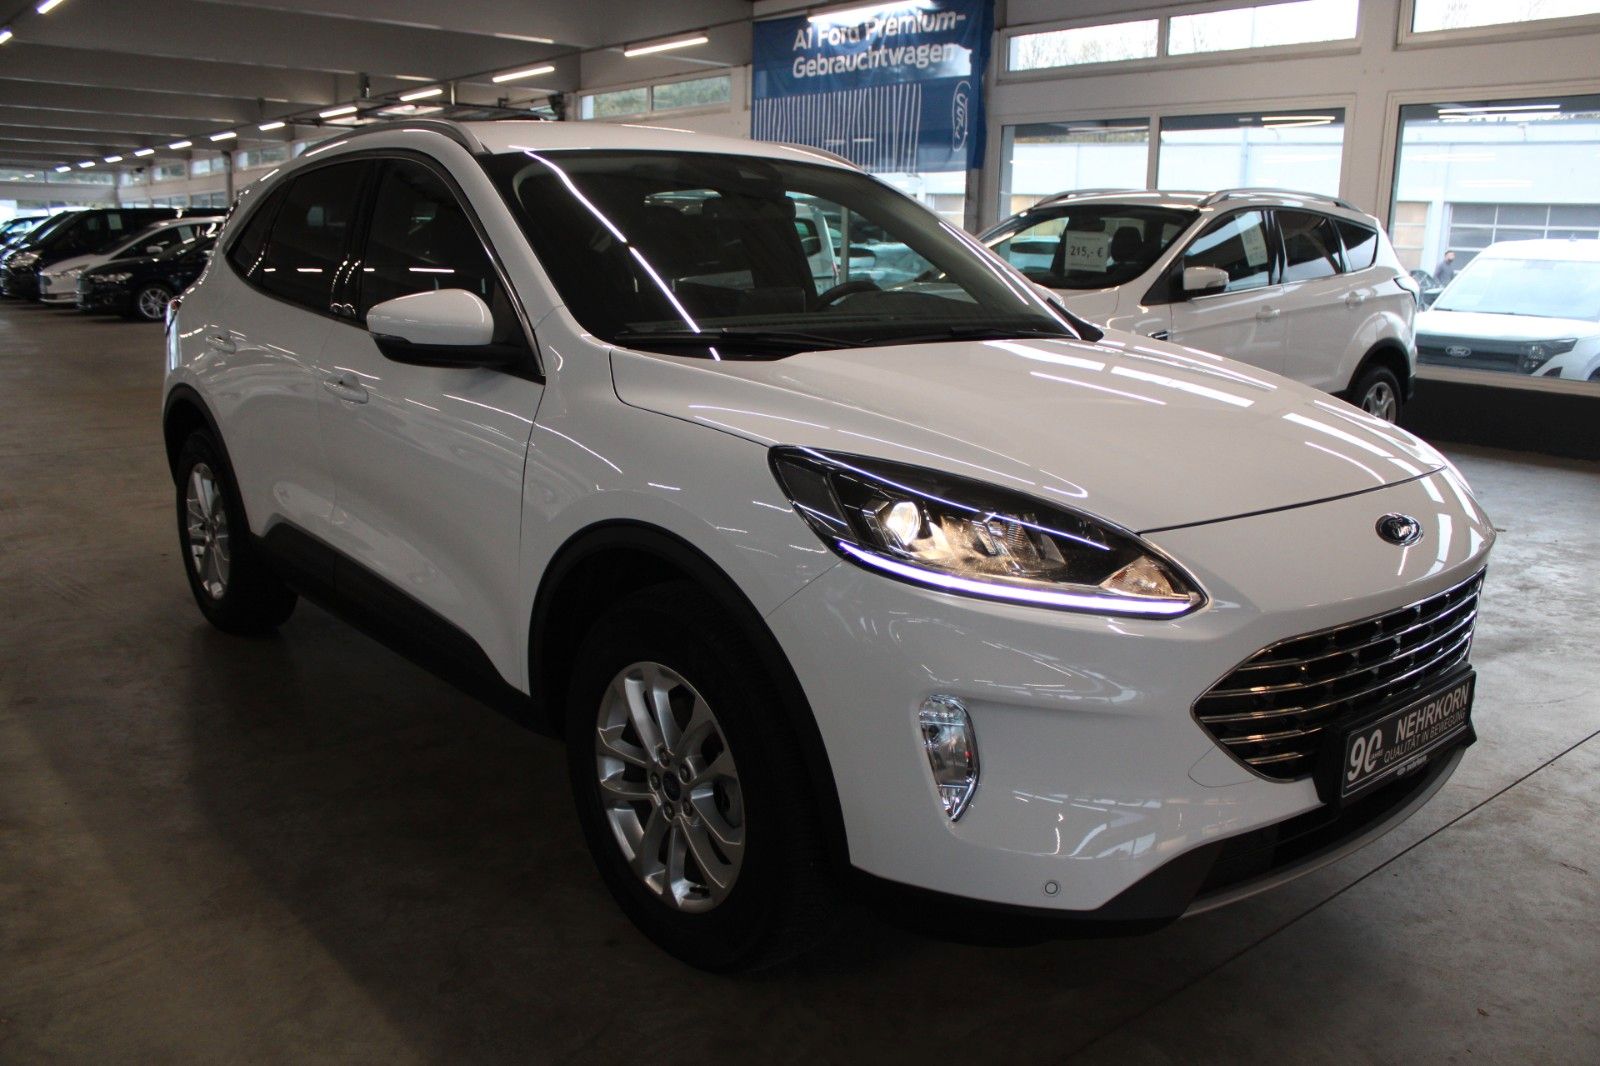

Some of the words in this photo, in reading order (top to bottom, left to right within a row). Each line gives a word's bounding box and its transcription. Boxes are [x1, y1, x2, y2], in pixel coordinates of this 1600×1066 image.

[793, 29, 813, 51] A1
[866, 10, 966, 41] Premium-
[792, 43, 957, 79] Gebrauchtwagen
[1395, 682, 1470, 744] NEHRKORN
